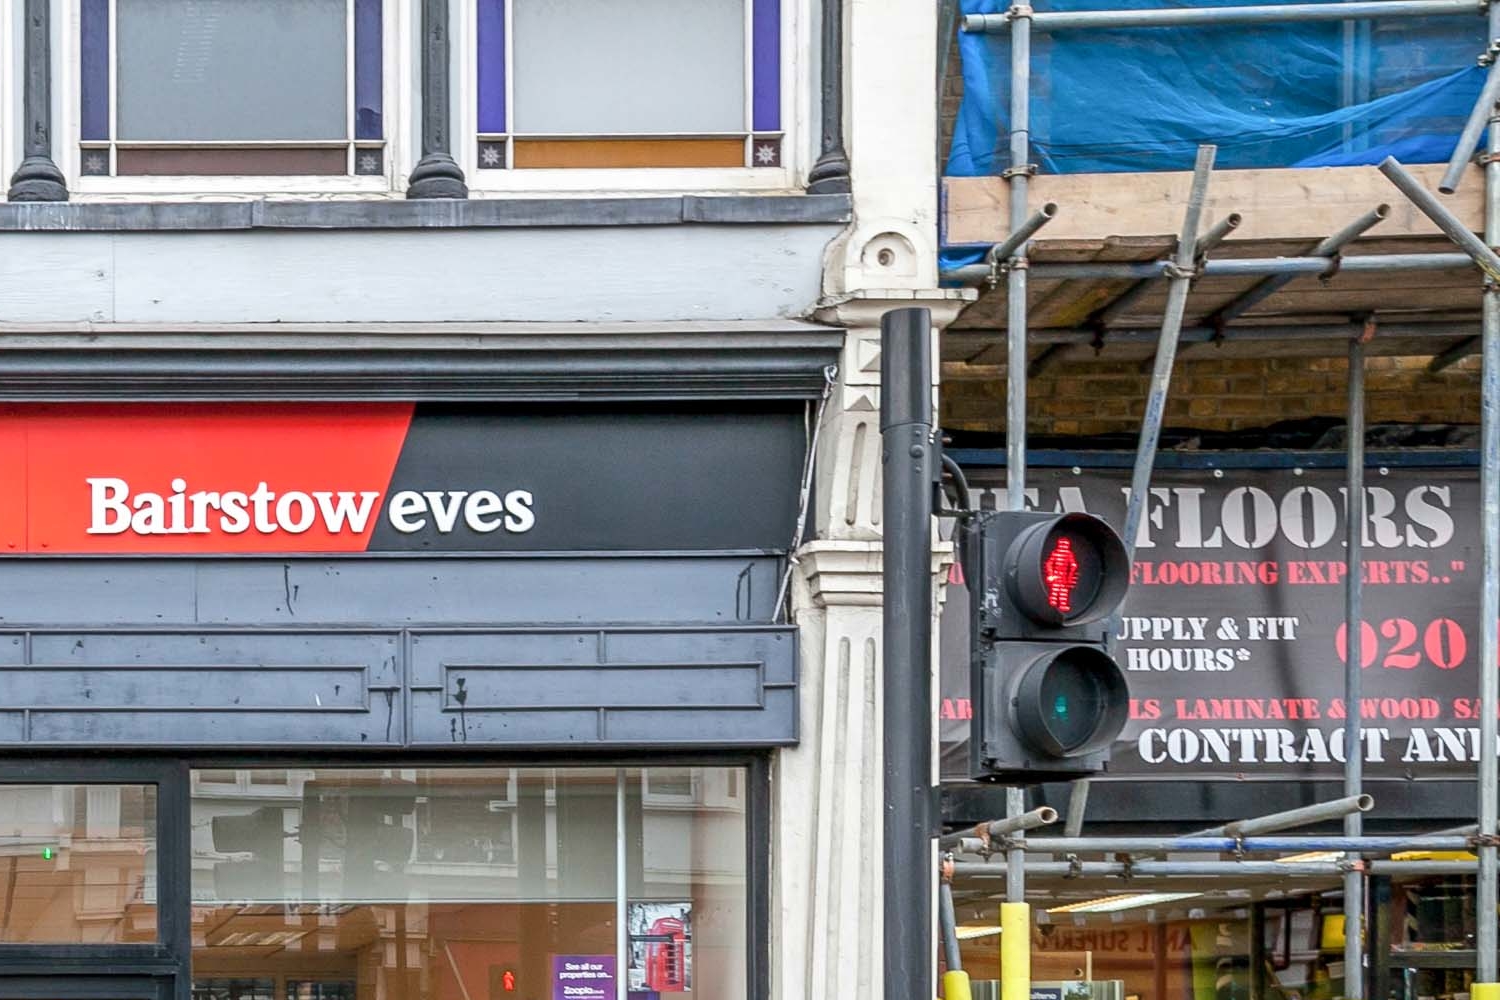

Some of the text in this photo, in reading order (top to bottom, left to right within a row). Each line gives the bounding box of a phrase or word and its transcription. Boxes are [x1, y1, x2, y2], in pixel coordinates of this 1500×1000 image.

[85, 477, 536, 535] Bairstow eves
[1121, 484, 1456, 549] FLOORS
[1128, 560, 1466, 585] FLOORING EXPRTS.."
[1216, 617, 1241, 641] &
[1247, 616, 1300, 641] FIT
[1334, 617, 1468, 671] 020
[1176, 698, 1320, 720] LAMINATE
[1360, 698, 1441, 720] WOOD
[1137, 727, 1390, 764] CONTRACT
